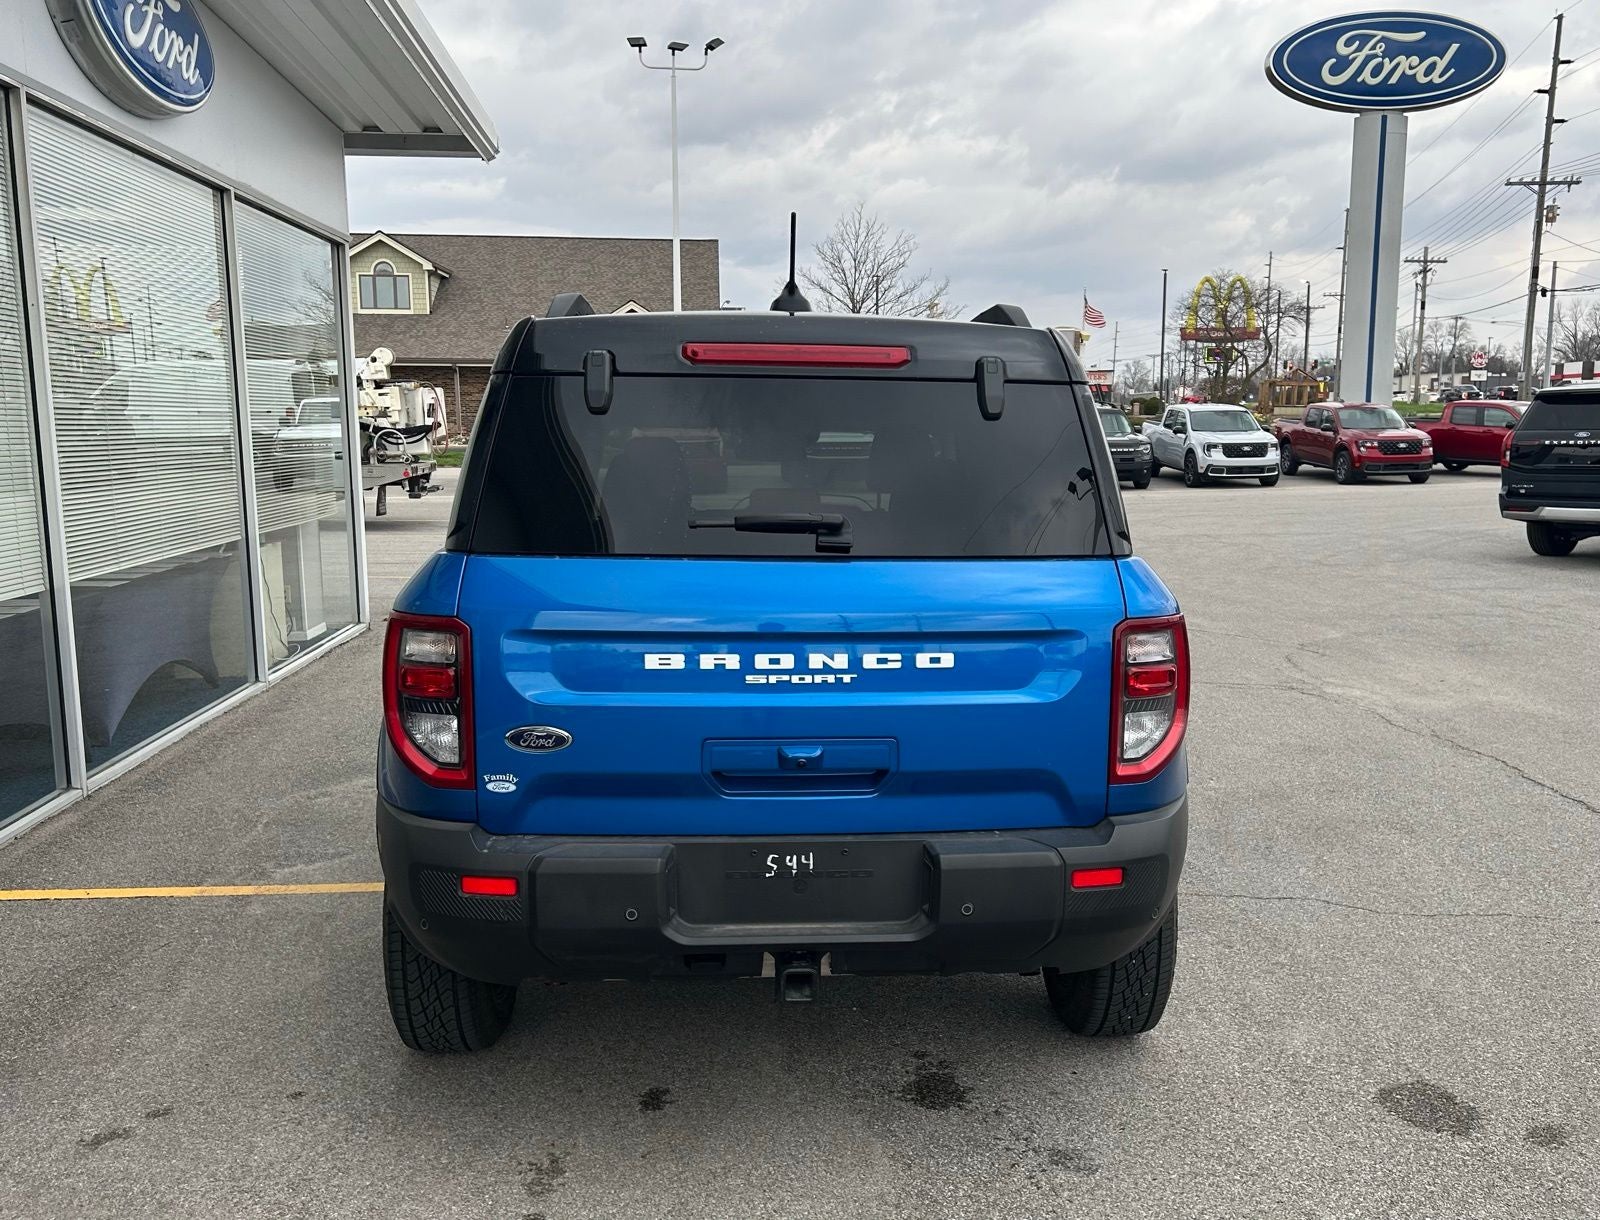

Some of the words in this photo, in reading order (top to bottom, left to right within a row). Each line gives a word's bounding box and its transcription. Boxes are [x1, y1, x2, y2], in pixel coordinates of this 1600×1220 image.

[124, 0, 200, 85] Ford
[1321, 29, 1460, 85] Ford
[644, 652, 955, 670] BRONCO
[745, 674, 858, 684] SPORT
[520, 731, 556, 747] Ford
[483, 773, 519, 784] Family
[491, 783, 511, 791] Ford
[765, 852, 814, 877] 544
